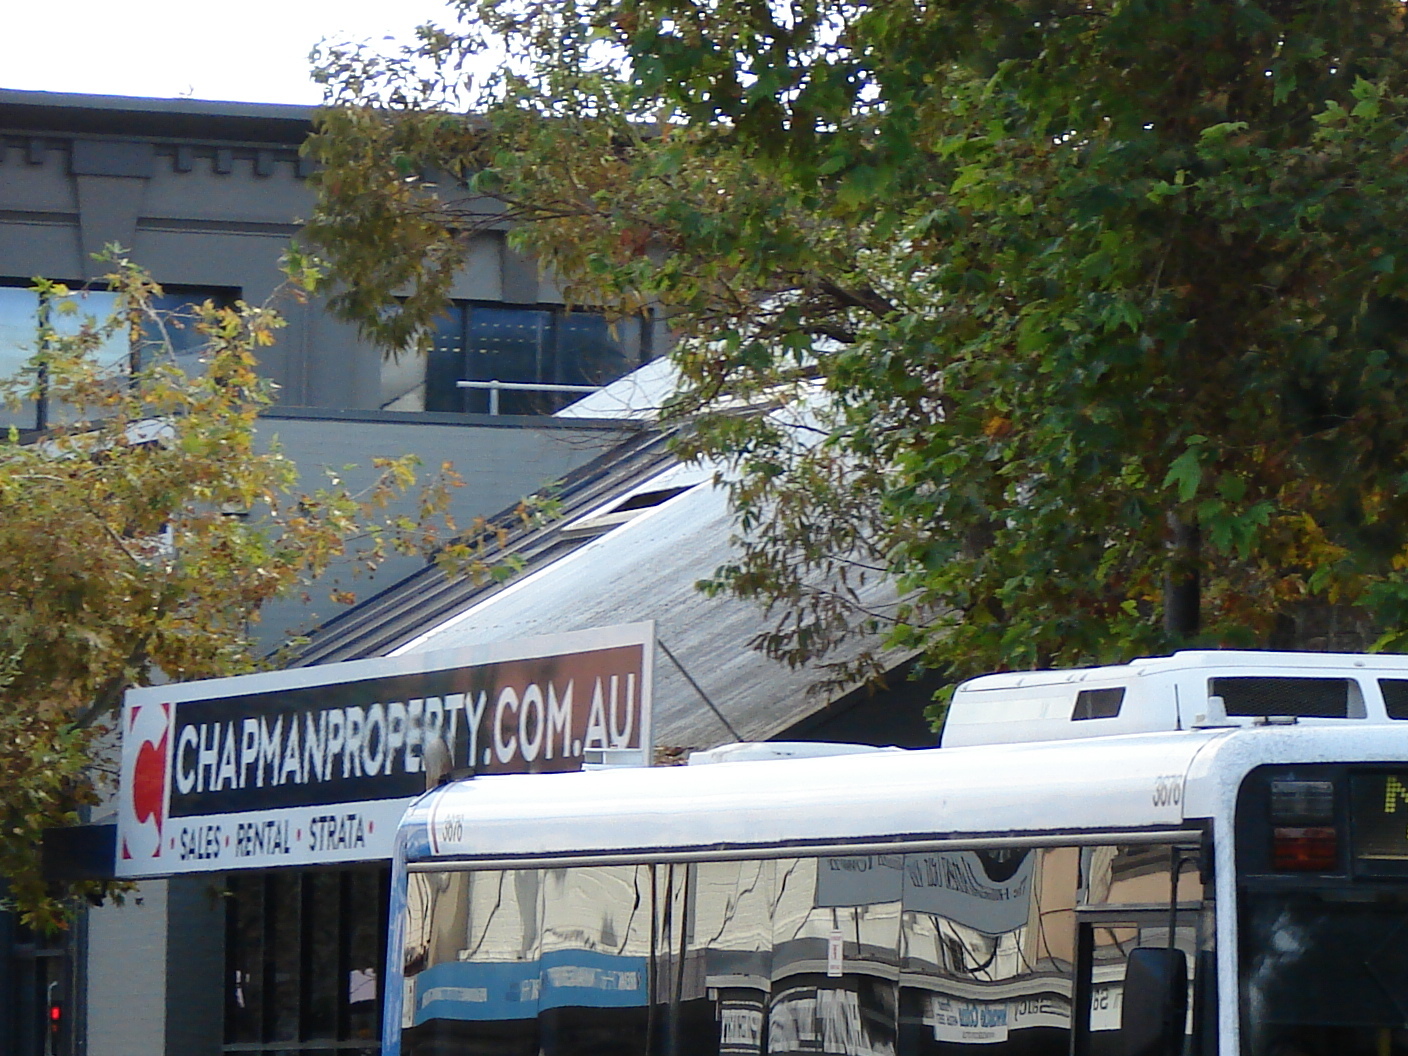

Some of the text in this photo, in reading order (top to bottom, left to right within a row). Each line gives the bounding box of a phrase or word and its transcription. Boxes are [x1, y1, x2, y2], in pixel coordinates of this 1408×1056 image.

[175, 673, 636, 795] CHAPMANPROPERTY.COM.AU
[179, 813, 366, 861] SALES RENTAL STRATA
